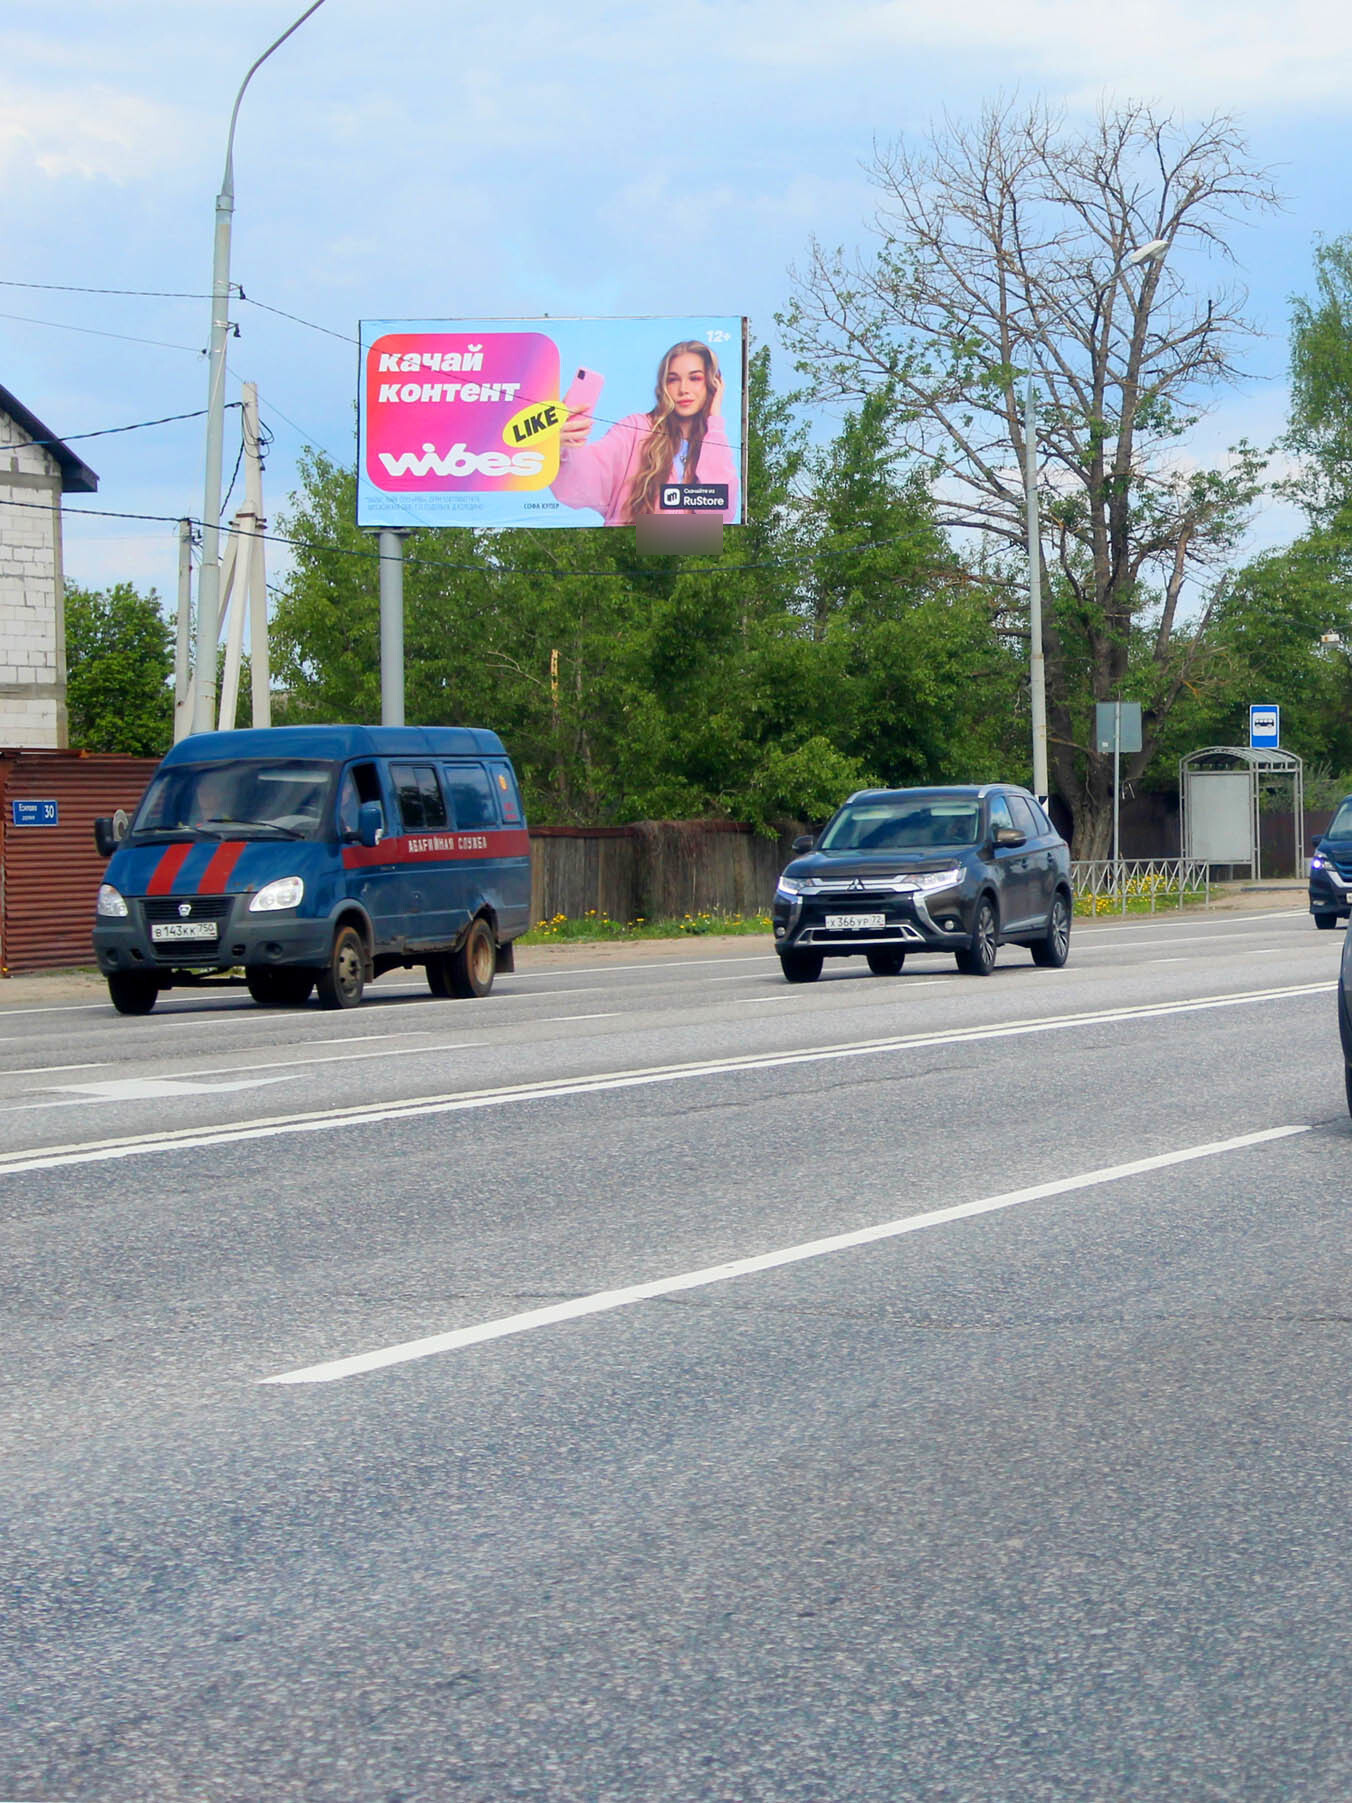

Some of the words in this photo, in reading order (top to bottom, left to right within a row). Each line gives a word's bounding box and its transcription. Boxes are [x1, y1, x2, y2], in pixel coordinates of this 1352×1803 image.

[705, 330, 731, 343] 12+
[378, 344, 484, 372] качай
[378, 383, 521, 403] контент
[513, 406, 559, 442] LIKE
[378, 443, 545, 477] wibes
[683, 496, 725, 506] RuStore
[44, 804, 55, 819] 30
